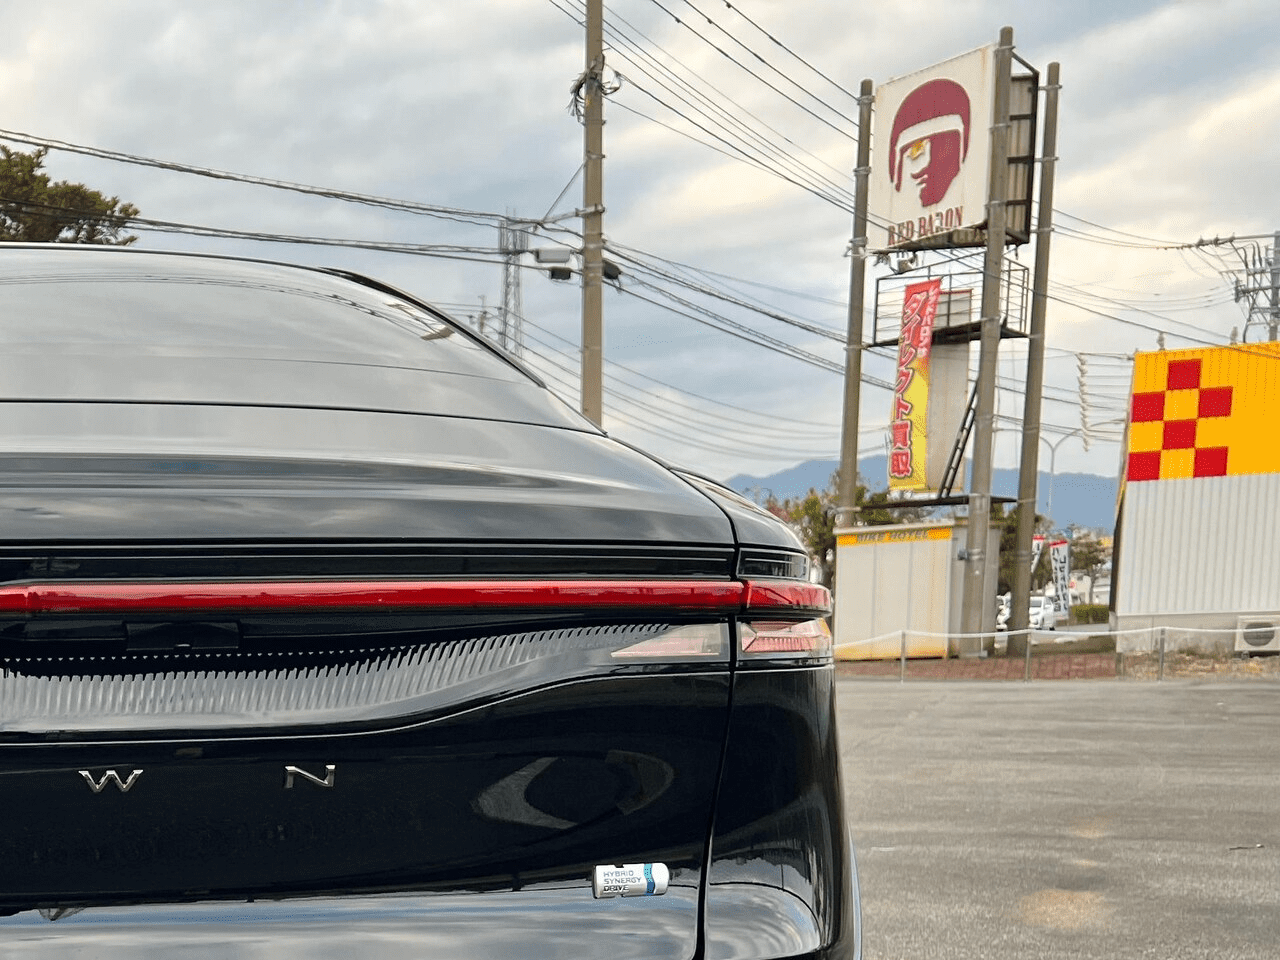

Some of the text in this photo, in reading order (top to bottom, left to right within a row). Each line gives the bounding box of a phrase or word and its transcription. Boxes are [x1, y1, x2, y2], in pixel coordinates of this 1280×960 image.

[887, 220, 914, 246] RED
[890, 290, 929, 478] ダイレクト買取
[603, 870, 634, 878] HYBRID
[603, 876, 642, 885] SYNERGY
[603, 884, 630, 892] DRIVE
